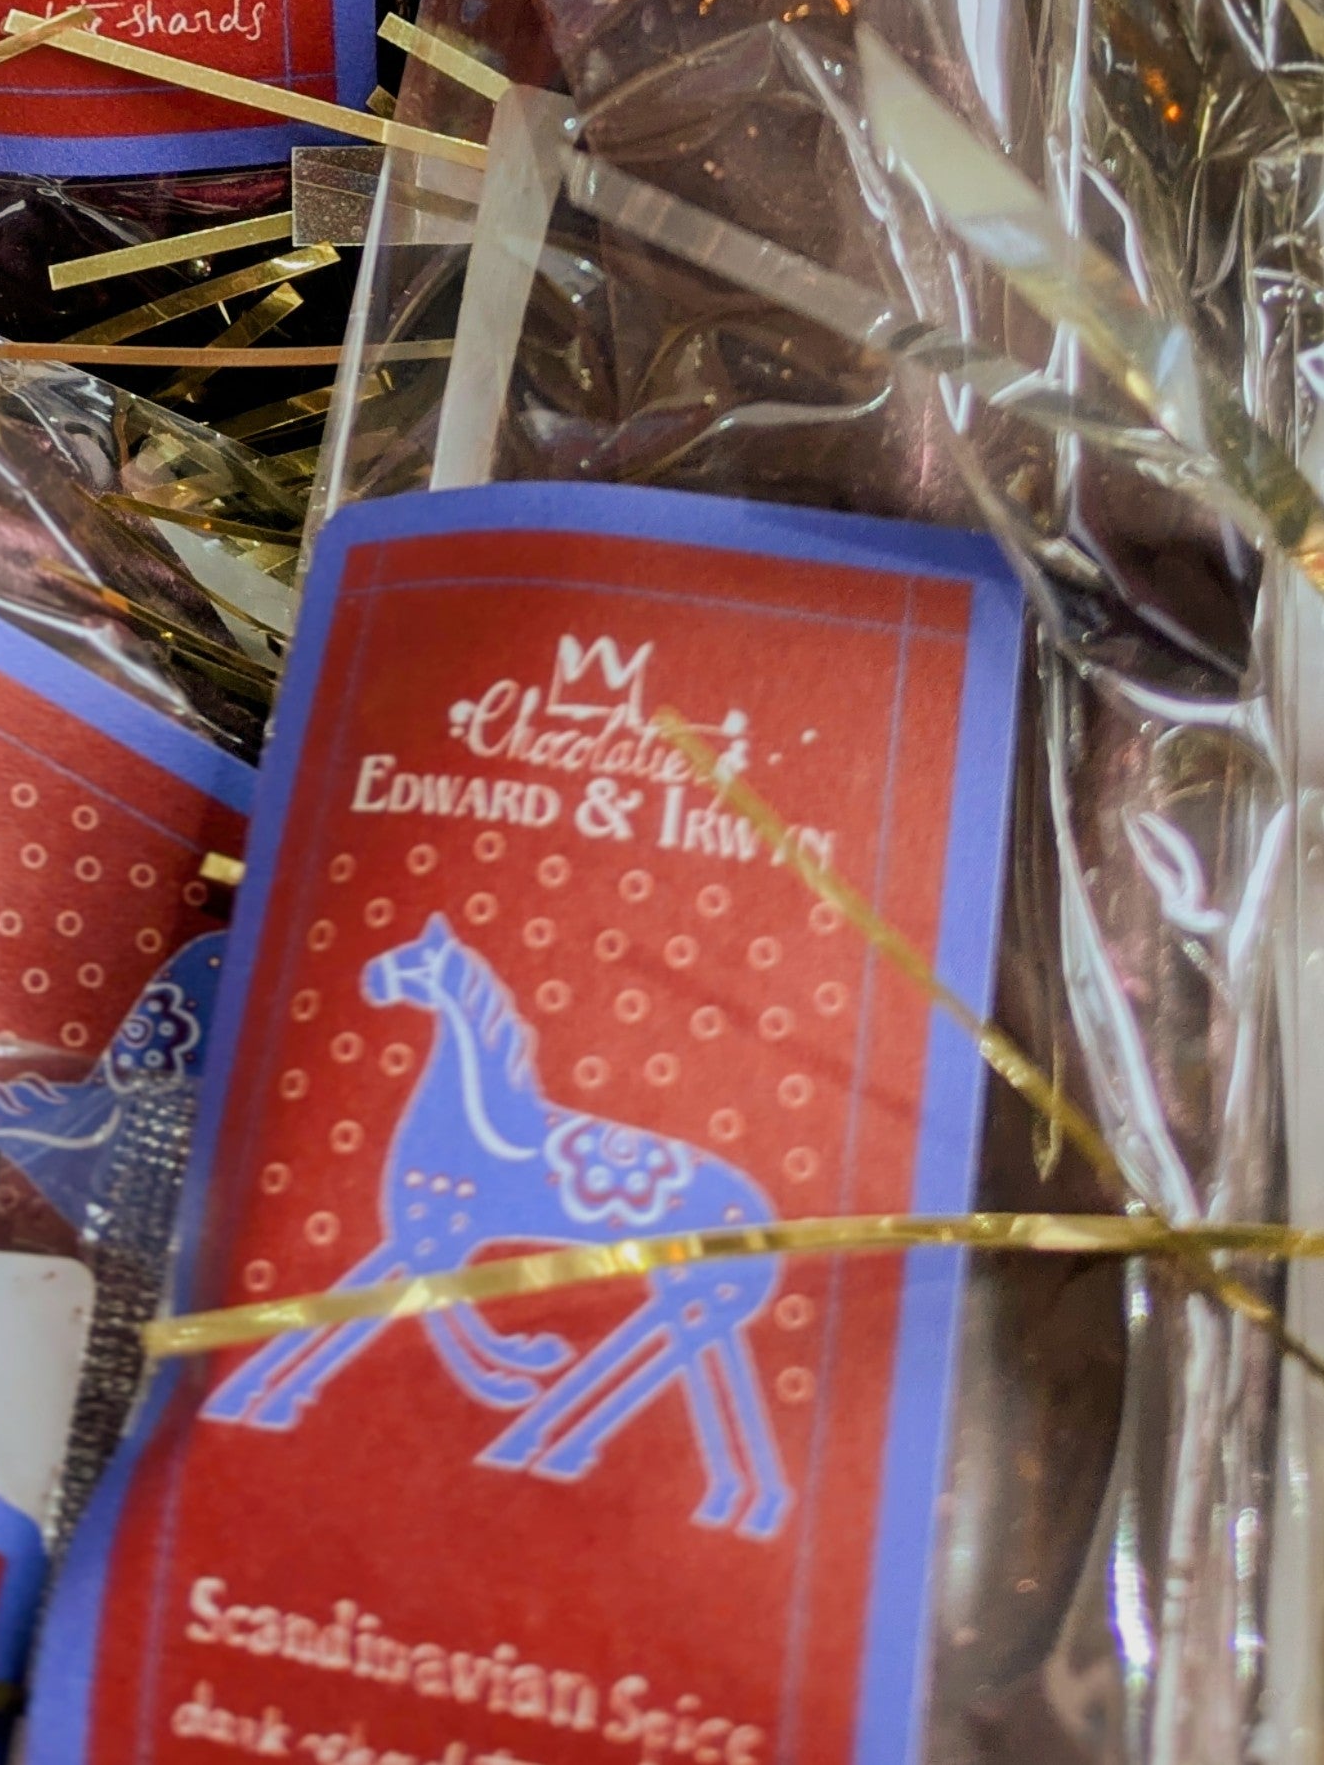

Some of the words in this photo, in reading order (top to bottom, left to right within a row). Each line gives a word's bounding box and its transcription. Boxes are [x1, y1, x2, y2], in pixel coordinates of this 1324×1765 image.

[351, 754, 560, 828] EDWARD
[575, 777, 644, 840] &
[186, 1576, 597, 1733] Scandinavian
[603, 1674, 766, 1765] Spice
